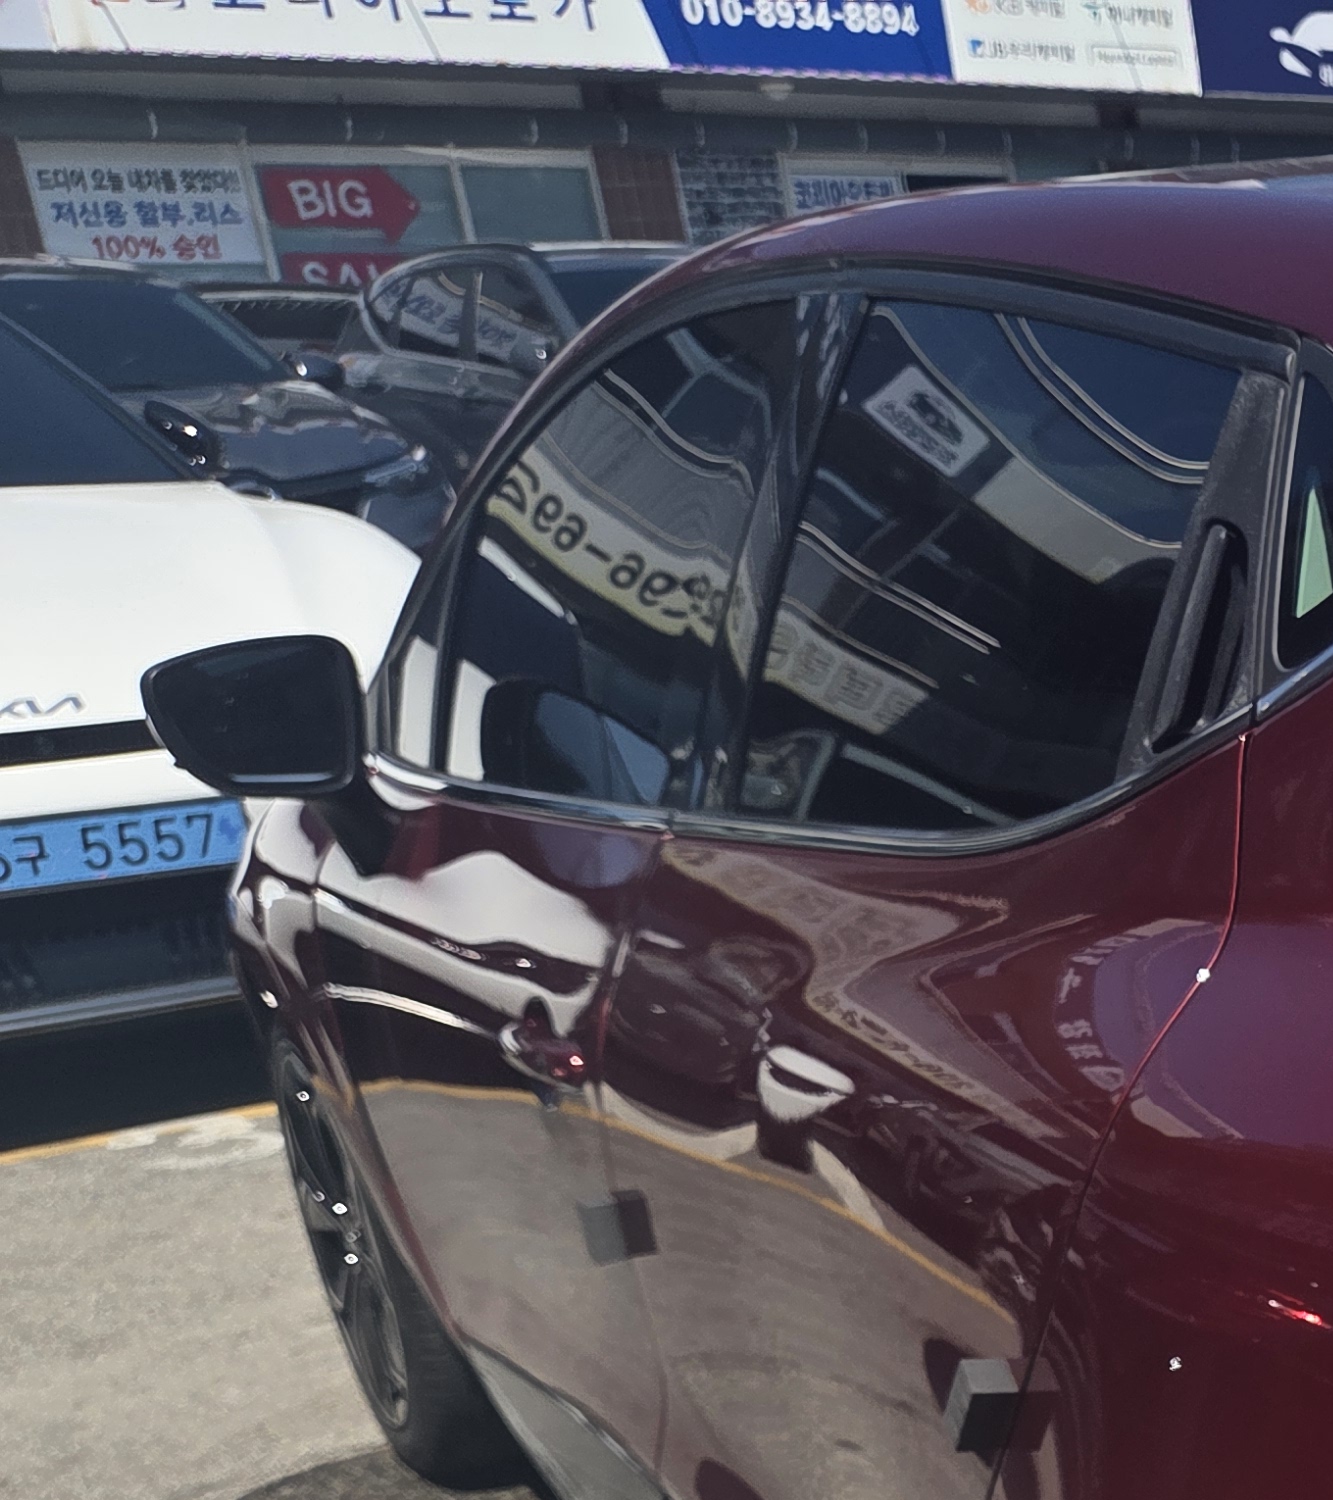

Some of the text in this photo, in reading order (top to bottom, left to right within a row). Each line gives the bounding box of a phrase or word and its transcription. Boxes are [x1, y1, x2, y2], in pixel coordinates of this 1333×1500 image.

[681, 0, 920, 37] 010-8934-8894
[51, 201, 128, 229] 저신용
[287, 179, 373, 220] BIG
[92, 234, 166, 260] 100%
[80, 813, 213, 872] 5557
